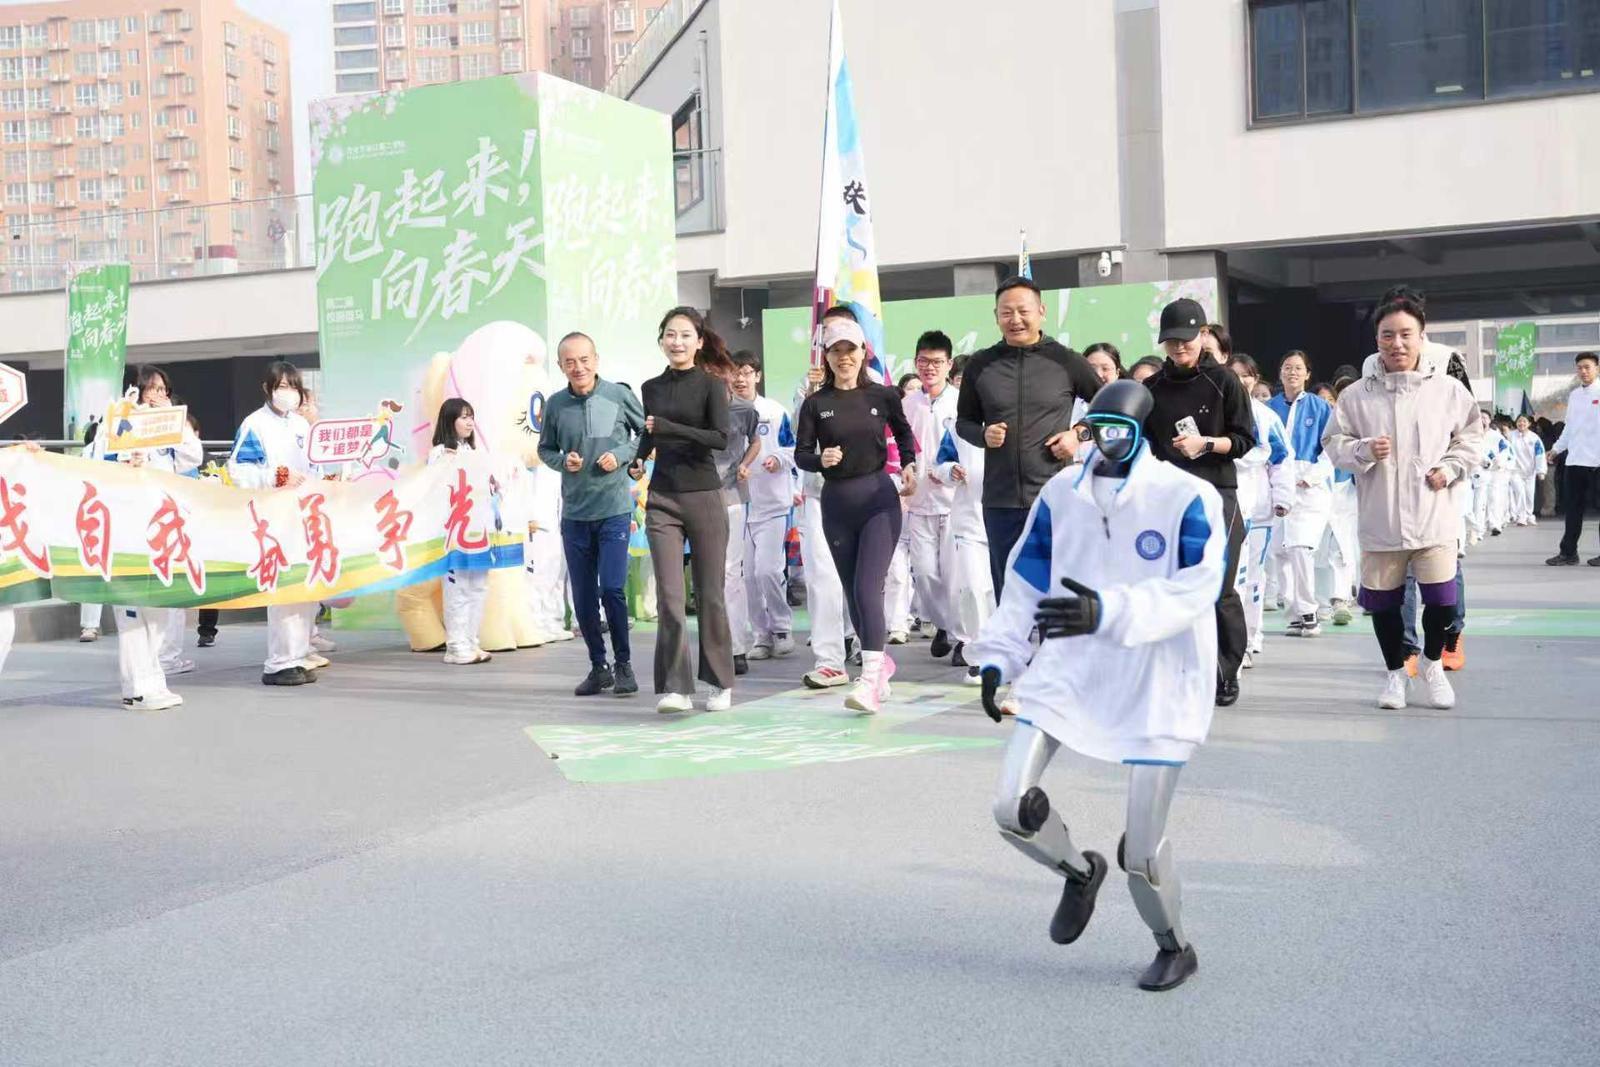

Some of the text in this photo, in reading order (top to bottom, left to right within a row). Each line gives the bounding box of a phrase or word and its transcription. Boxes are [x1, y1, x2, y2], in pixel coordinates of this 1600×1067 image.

[316, 129, 538, 284] 跑起来！
[371, 217, 547, 347] 向春天
[318, 424, 373, 442] 我们都是
